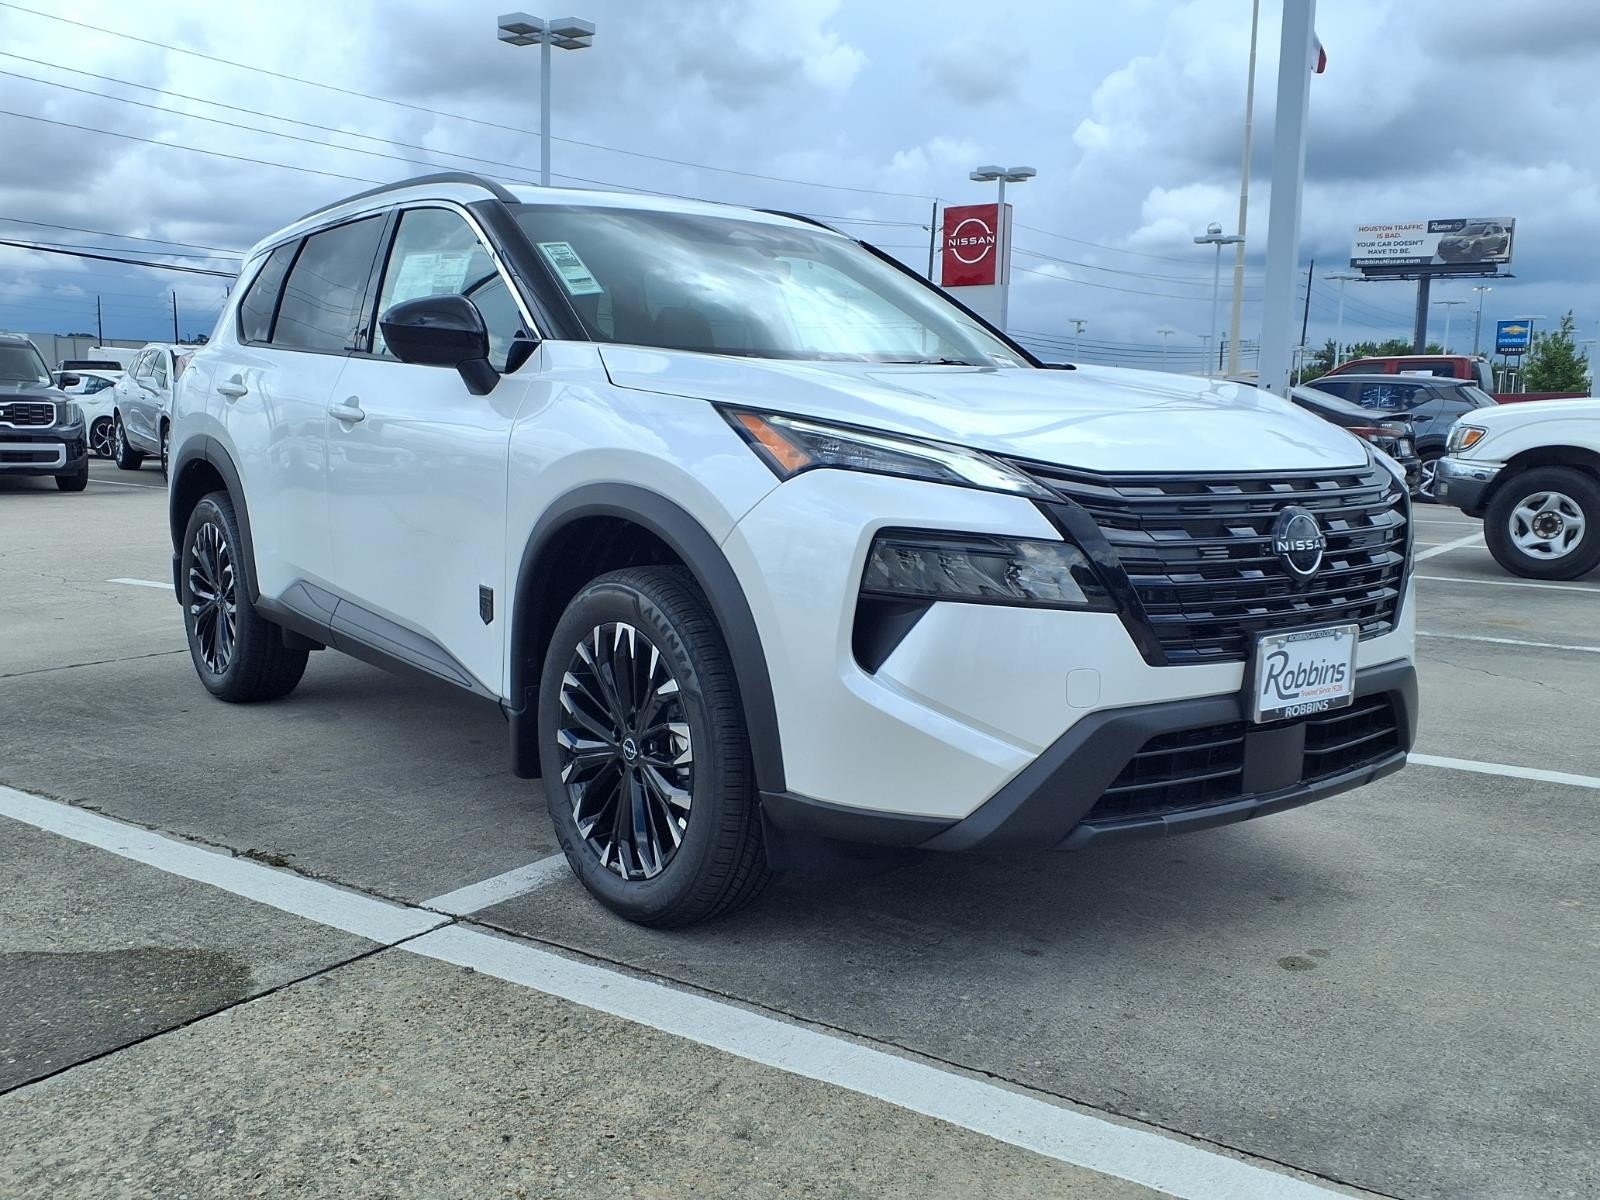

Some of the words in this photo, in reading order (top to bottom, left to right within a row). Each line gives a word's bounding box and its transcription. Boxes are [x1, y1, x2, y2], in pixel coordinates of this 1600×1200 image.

[1358, 225, 1393, 233] HOUSTON
[1394, 223, 1424, 231] TRAFFIC
[948, 235, 995, 247] NISSAN
[1393, 239, 1424, 247] DOESN'T
[1263, 650, 1346, 700] Robbins
[1284, 699, 1329, 718] ROBBINS
